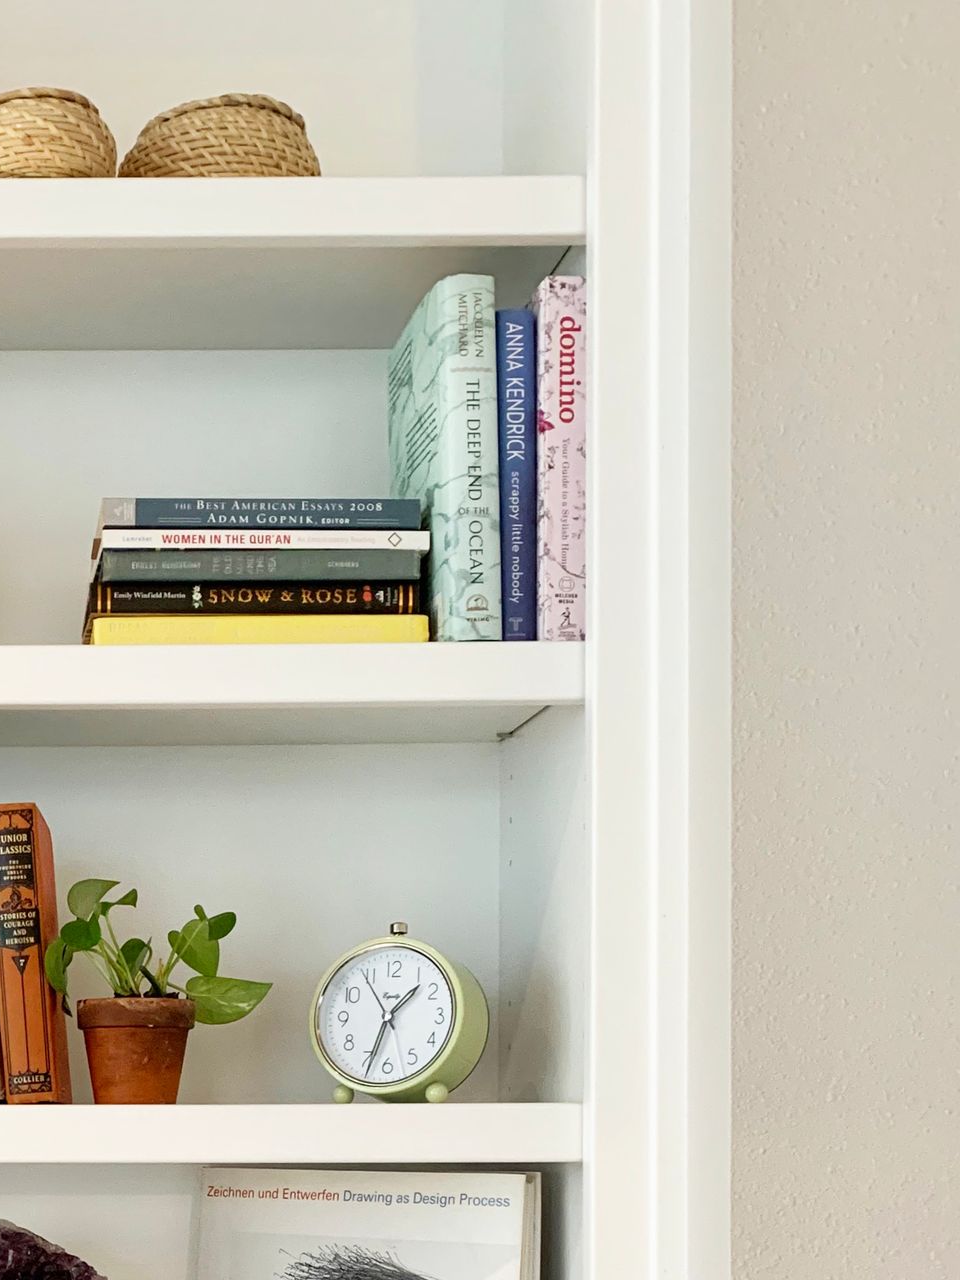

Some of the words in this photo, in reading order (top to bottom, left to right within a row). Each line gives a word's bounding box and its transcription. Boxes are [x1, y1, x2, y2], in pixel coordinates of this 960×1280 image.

[458, 293, 468, 357] MITCHARD
[472, 292, 484, 358] JACQUELYN
[506, 322, 524, 371] ANNA
[559, 316, 582, 424] domino
[466, 378, 480, 411] THE
[506, 377, 525, 460] KENDRICK
[467, 419, 481, 459] DEEP
[562, 438, 571, 461] Your
[468, 466, 482, 500] END
[562, 462, 570, 490] Guide
[508, 472, 520, 520] scrappy
[196, 500, 226, 510] BEST
[231, 500, 296, 511] AMERICAN
[301, 500, 344, 512] ESSAYS
[350, 502, 383, 512] 2008
[458, 507, 470, 515] OF
[473, 506, 489, 514] THE
[206, 513, 249, 524] ADAM
[256, 513, 318, 525] GOPNIK,
[560, 509, 570, 542] Stylish
[162, 534, 206, 544] WOMEN
[210, 534, 222, 544] IN
[225, 534, 246, 544] THE
[249, 534, 291, 544] QUR'AN
[512, 524, 524, 552] little
[468, 520, 484, 584] OCEAN
[509, 556, 524, 604] nobody
[114, 592, 133, 600] Emily
[208, 588, 274, 604] SNOW
[280, 589, 295, 602] &
[300, 588, 358, 604] ROSE
[0, 913, 26, 921] STORIES
[4, 920, 34, 928] COURAGE
[387, 961, 402, 978] 12
[345, 986, 360, 1003] 10
[428, 983, 438, 1000] 2
[338, 1011, 349, 1027] 9
[434, 1007, 445, 1024] 3
[344, 1034, 354, 1051] 8
[427, 1032, 436, 1048] 4
[362, 1051, 373, 1068] 7
[407, 1048, 418, 1065] 5
[382, 1058, 393, 1074] 6
[13, 1075, 45, 1084] COLLIER
[207, 1185, 255, 1198] Zeichnen
[258, 1188, 279, 1199] und
[282, 1188, 340, 1201] Entwerfen
[343, 1190, 393, 1206] Drawing
[396, 1195, 410, 1204] as
[413, 1192, 456, 1208] Design
[459, 1193, 511, 1208] Process
